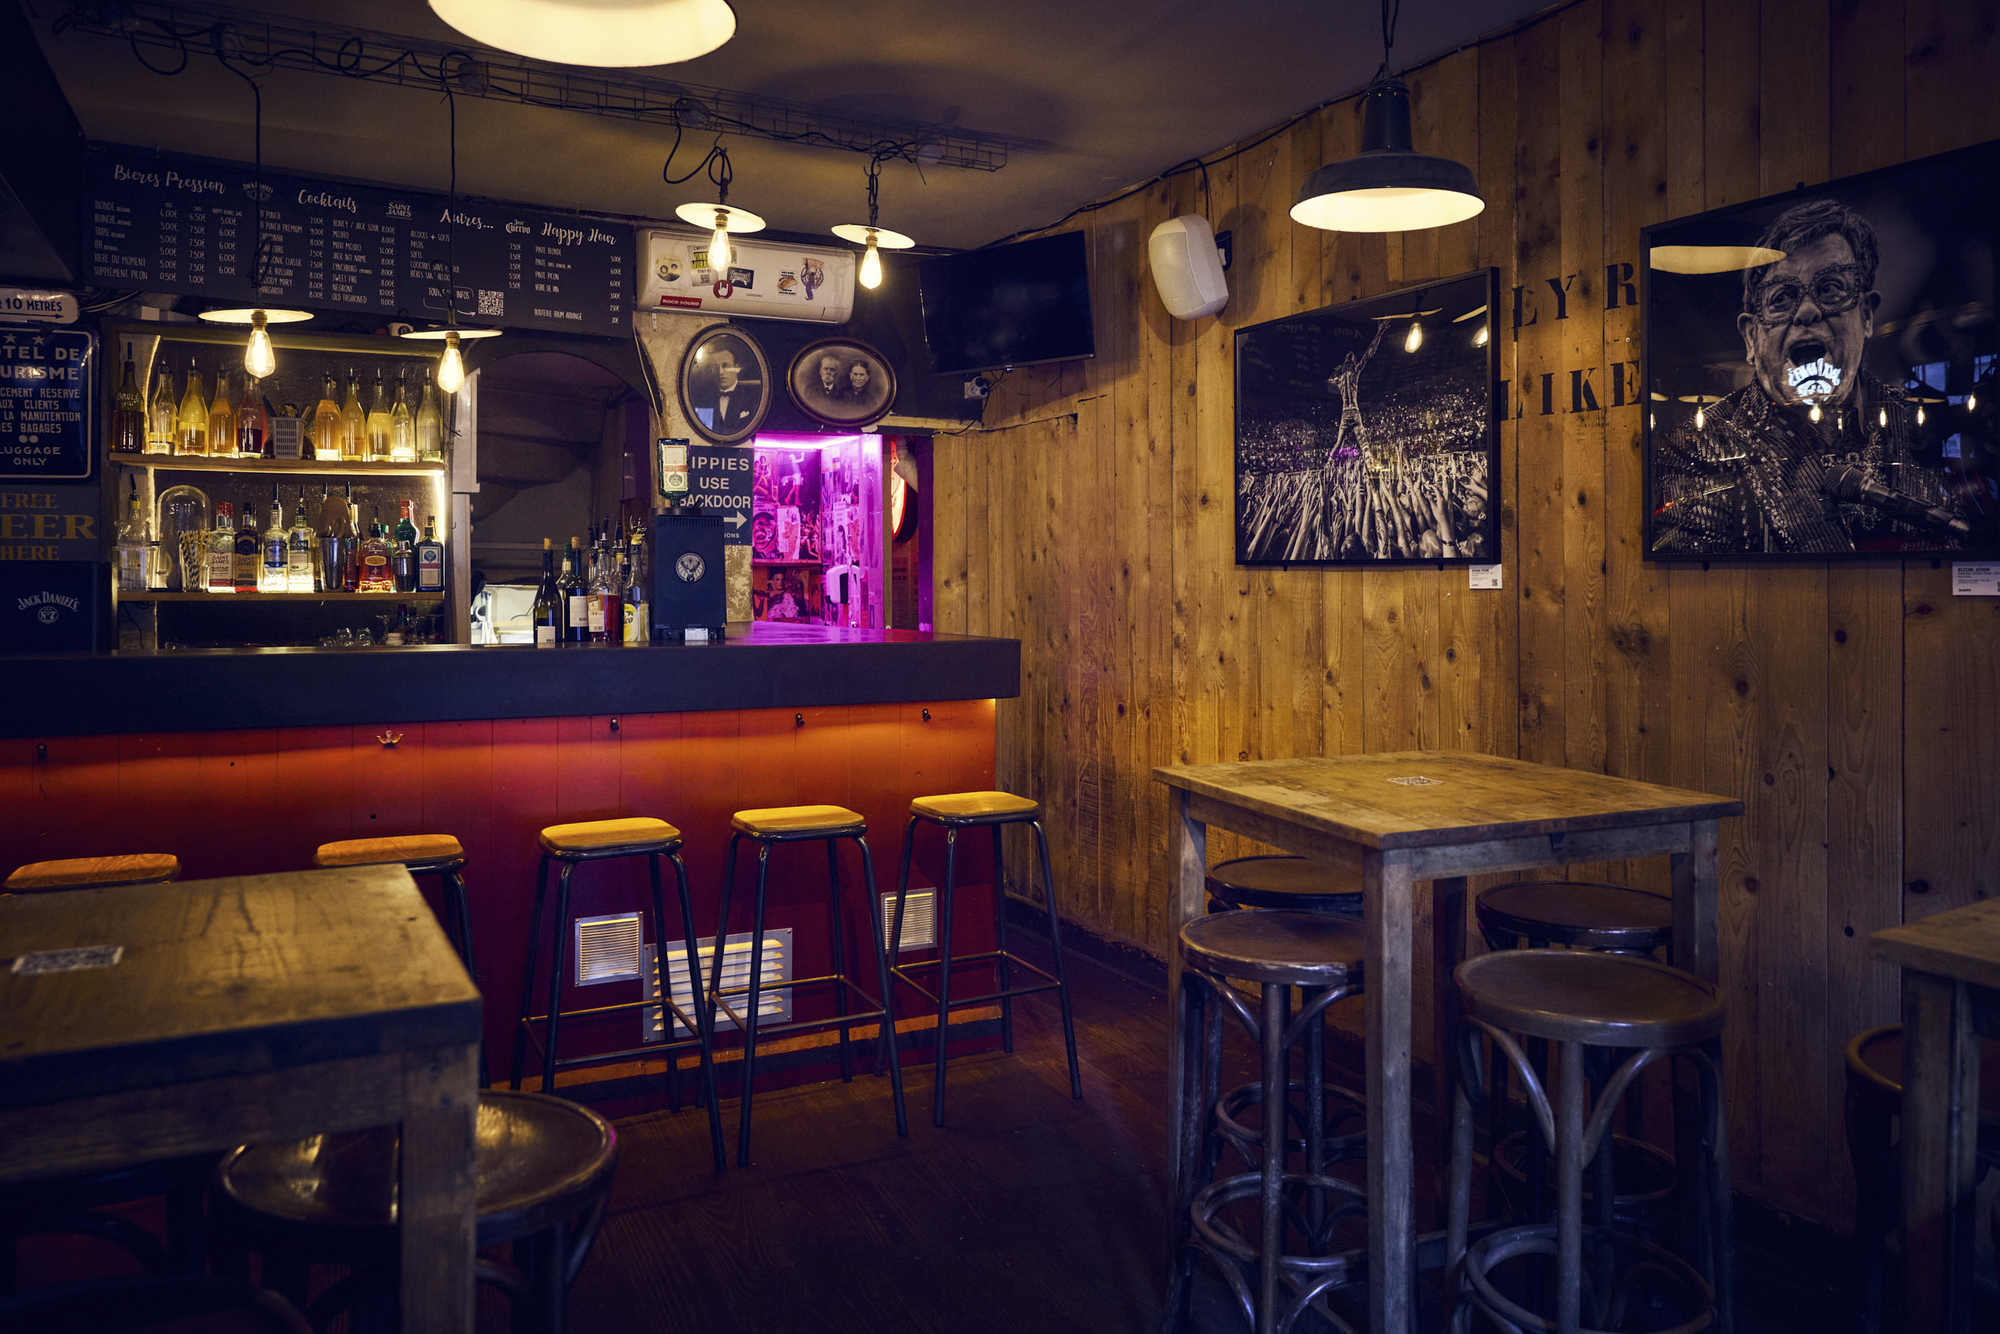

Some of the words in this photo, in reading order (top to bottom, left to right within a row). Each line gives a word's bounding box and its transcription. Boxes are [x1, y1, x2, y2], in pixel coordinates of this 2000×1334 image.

[166, 171, 224, 194] Pression
[298, 189, 357, 213] Cocktails
[540, 222, 583, 246] Happy
[588, 228, 617, 245] Hour
[6, 297, 22, 310] 10
[0, 345, 45, 360] TEL
[56, 347, 80, 361] DE
[1500, 360, 1642, 422] LIKE
[24, 400, 60, 410] CLIENTS
[4, 411, 14, 421] LA
[20, 411, 81, 422] MANUTENTION
[0, 423, 13, 432] ES
[13, 457, 47, 466] ONLY
[691, 456, 750, 471] IPPIES
[699, 476, 729, 491] USE
[0, 493, 57, 509] FREE
